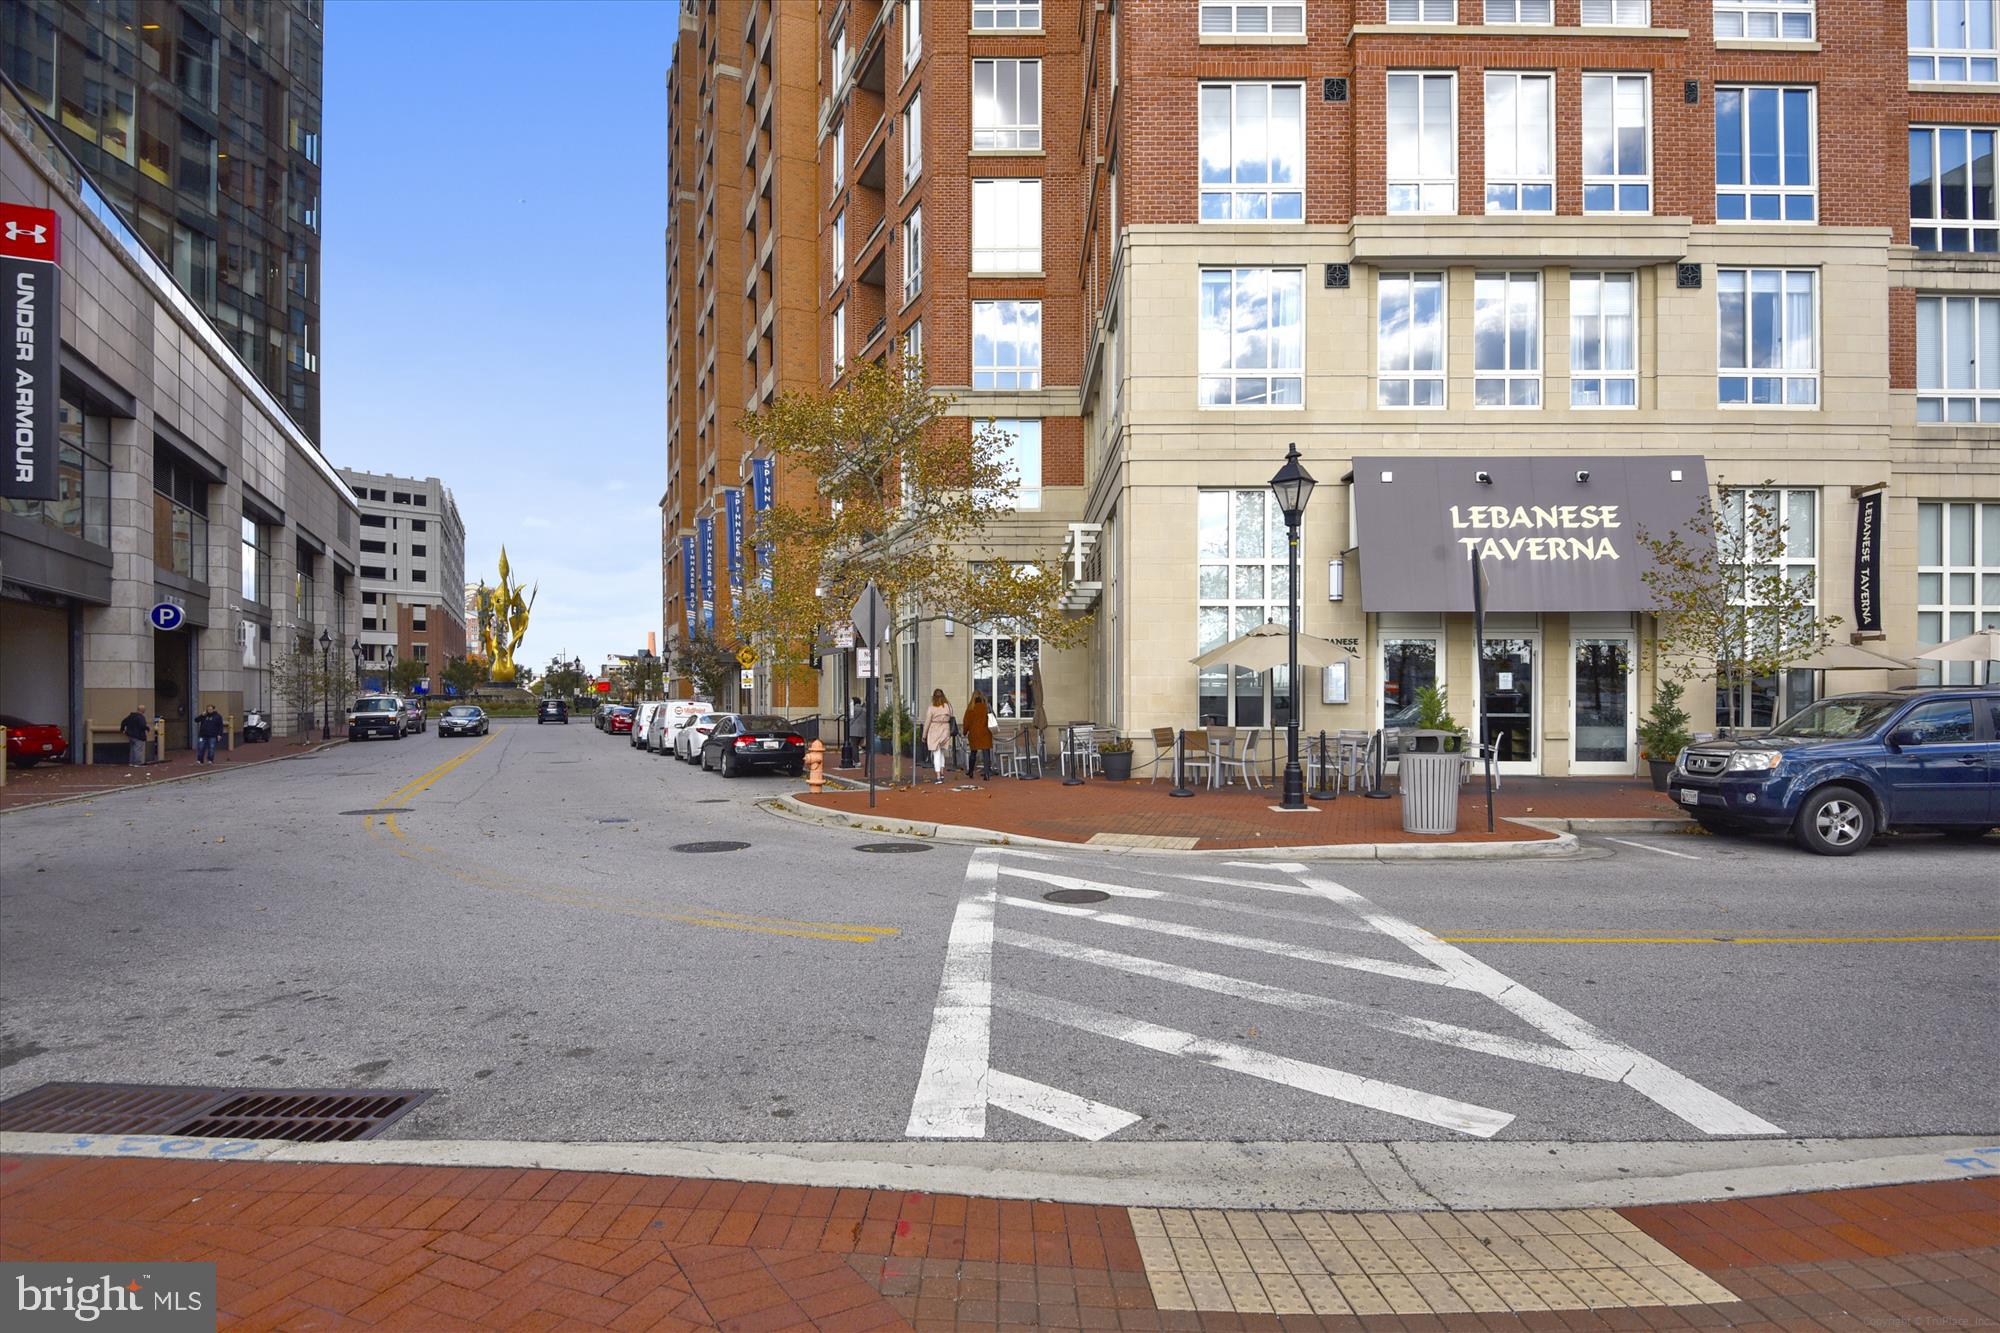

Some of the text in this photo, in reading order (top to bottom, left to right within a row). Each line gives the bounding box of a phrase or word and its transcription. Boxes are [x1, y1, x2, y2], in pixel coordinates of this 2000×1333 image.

[16, 272, 35, 483] UNDER ARMOUR
[1449, 505, 1621, 529] LEBANESE
[1457, 536, 1620, 561] TAVERNA
[1860, 501, 1873, 625] LEBANESE TAVERNA
[160, 608, 174, 625] P
[1322, 638, 1359, 646] ANESE
